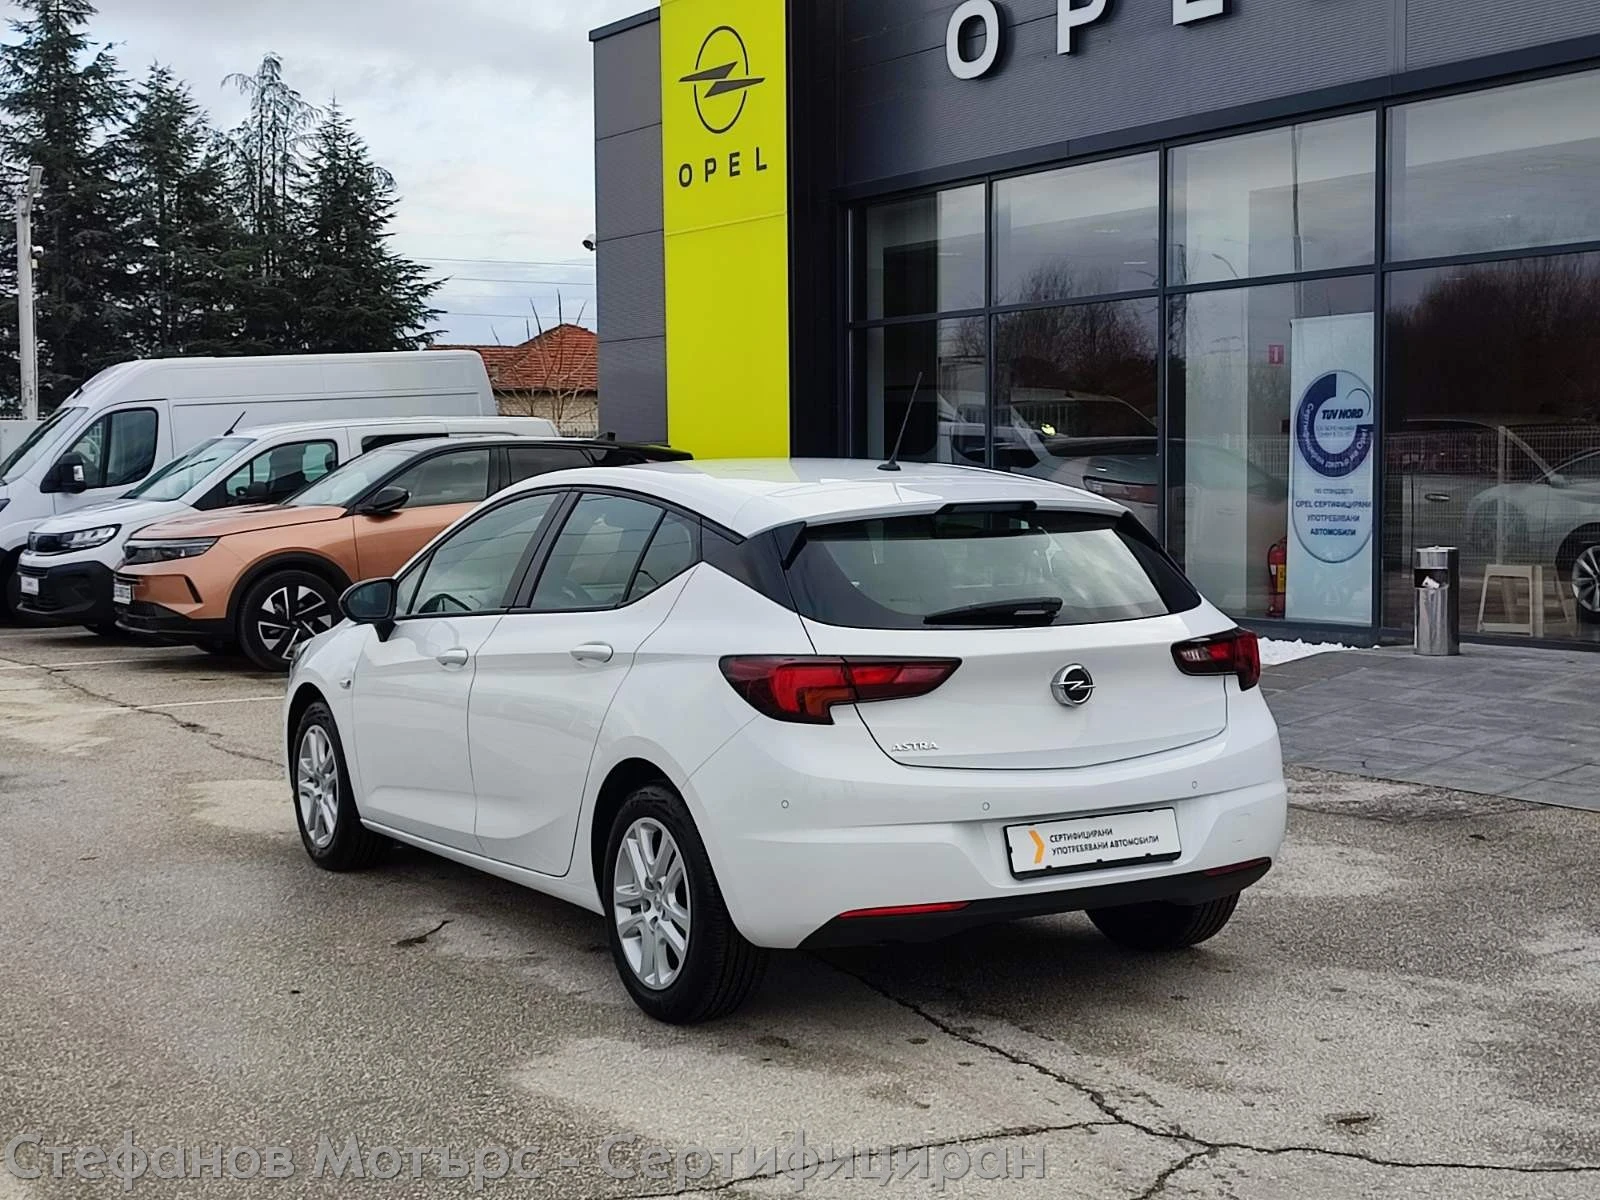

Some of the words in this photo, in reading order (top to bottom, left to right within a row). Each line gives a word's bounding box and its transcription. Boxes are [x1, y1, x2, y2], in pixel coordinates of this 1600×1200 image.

[679, 146, 768, 188] OPEL
[1338, 408, 1364, 419] NORD
[1295, 500, 1313, 508] OPEL
[1310, 527, 1357, 536] АВТОМОБИЛИ
[891, 741, 939, 752] ASTRA
[1049, 828, 1114, 843] СЕРТИФИЦИРАНИ
[1051, 840, 1109, 856] УПОТРЕБЯВАНИ
[1109, 835, 1160, 849] АВТОМОБИЛИ
